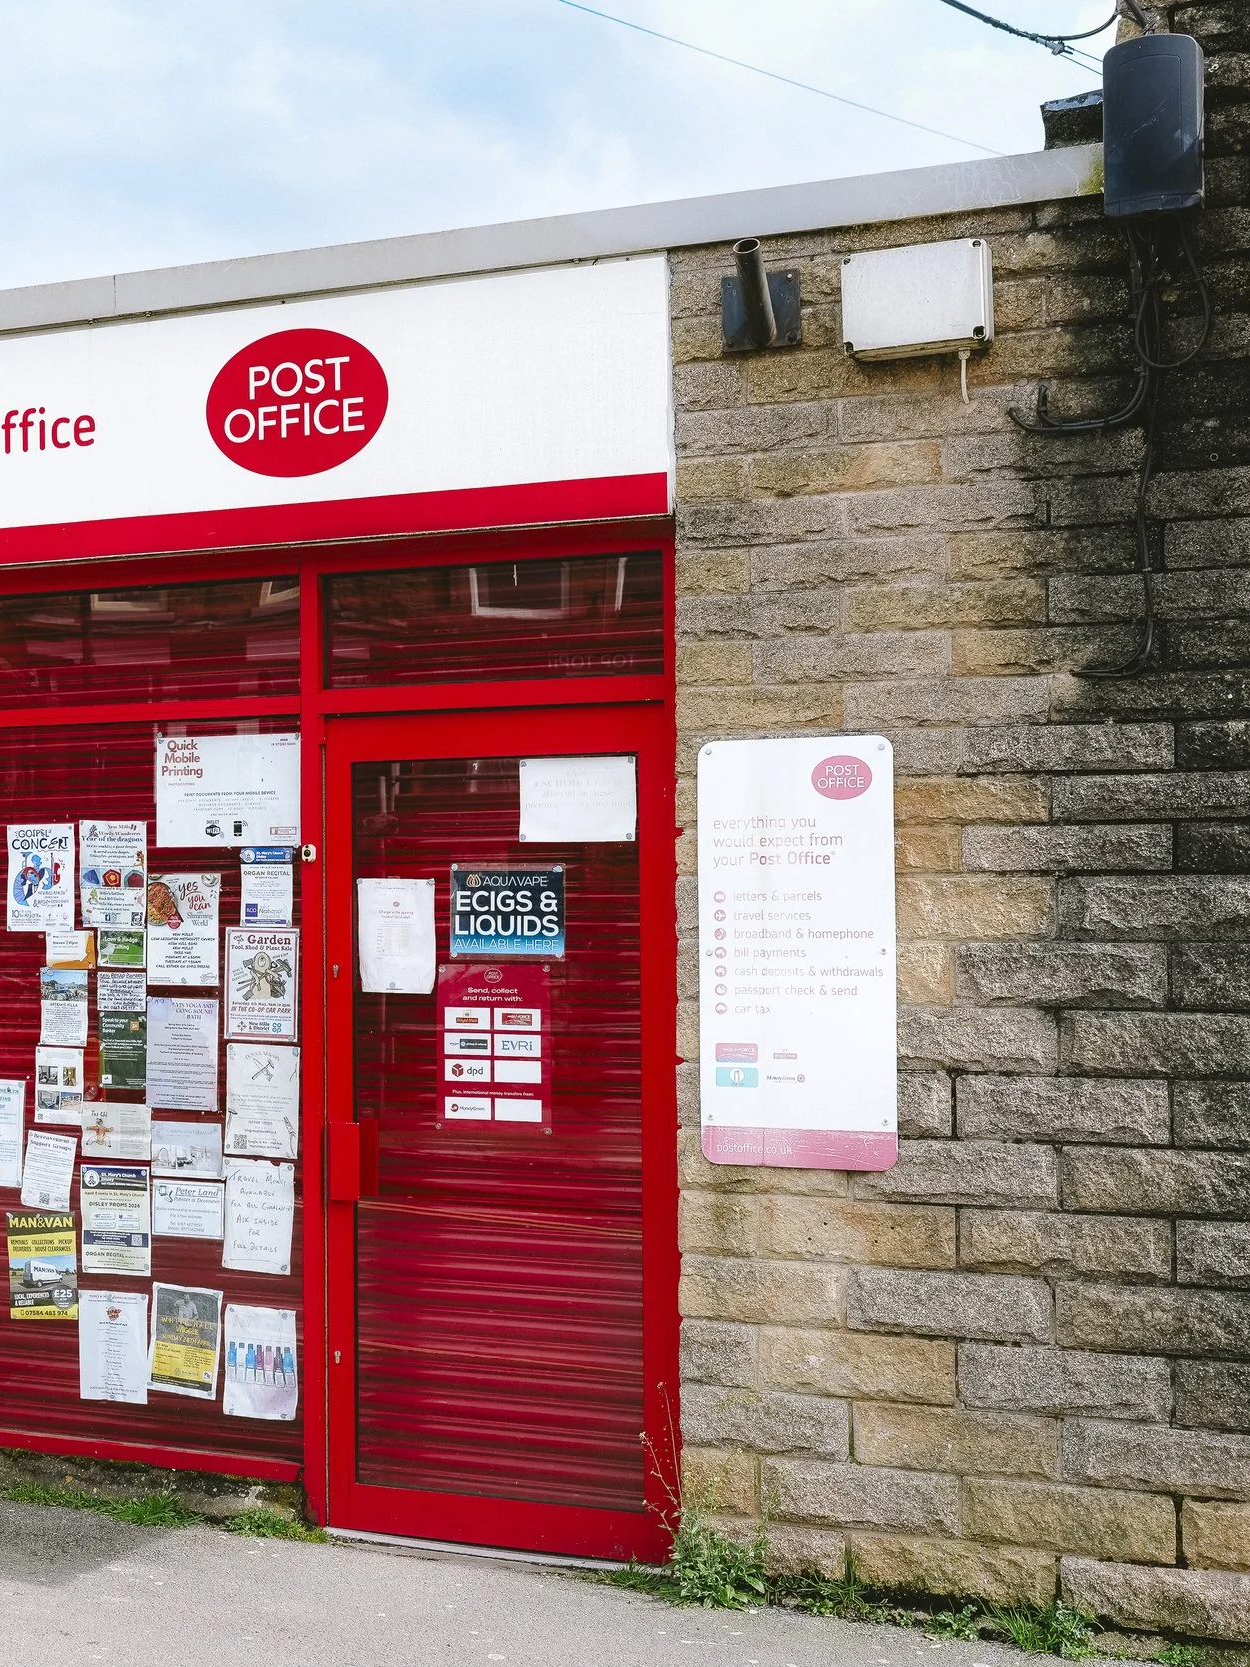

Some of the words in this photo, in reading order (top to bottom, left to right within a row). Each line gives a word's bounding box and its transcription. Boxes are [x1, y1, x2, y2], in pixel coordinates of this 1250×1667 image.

[249, 356, 350, 399] POST
[223, 397, 365, 443] OFFICE
[167, 740, 197, 752] Quick
[165, 753, 200, 763] Mobile
[162, 766, 203, 778] Printing
[826, 765, 859, 776] POST
[817, 777, 865, 788] OFFICE
[713, 816, 785, 831] everything
[791, 817, 816, 831] you
[18, 829, 49, 838] GOSPEL
[12, 837, 69, 850] CONCERT
[713, 835, 753, 848] would
[760, 835, 804, 849] expect
[810, 833, 843, 846] from
[713, 854, 744, 868] your
[750, 852, 781, 865] Post
[483, 876, 548, 886] AQUAVAPE
[179, 882, 199, 900] yes
[734, 891, 767, 901] letters
[772, 891, 778, 901] &
[784, 891, 822, 902] parcels
[188, 894, 205, 909] you
[194, 902, 211, 911] can
[456, 891, 532, 912] ECIGS
[540, 891, 558, 912] &
[734, 910, 763, 920] travel
[768, 911, 810, 920] services
[455, 915, 559, 936] LIQUIDS
[248, 935, 291, 944] Garden
[734, 929, 791, 939] broadband
[796, 928, 804, 938] &
[808, 929, 874, 940] homephone
[454, 939, 521, 950] AVAILABLE
[526, 940, 559, 951] HERE
[734, 948, 748, 958] bill
[754, 948, 806, 959] payments
[734, 967, 757, 976] cash
[762, 967, 804, 978] deposits
[809, 967, 816, 976] &
[820, 966, 883, 977] withdrawals
[734, 986, 780, 996] passport
[785, 985, 815, 995] check
[820, 985, 827, 995] &
[831, 985, 857, 996] send
[734, 1005, 751, 1014] car
[755, 1004, 771, 1014] tax
[467, 1067, 483, 1076] dpd
[717, 1143, 793, 1155] postoffice.co.uk
[175, 1187, 196, 1196] Peter
[198, 1188, 218, 1197] Land
[10, 1217, 73, 1228] MAN&VAN
[54, 1289, 72, 1298] £25
